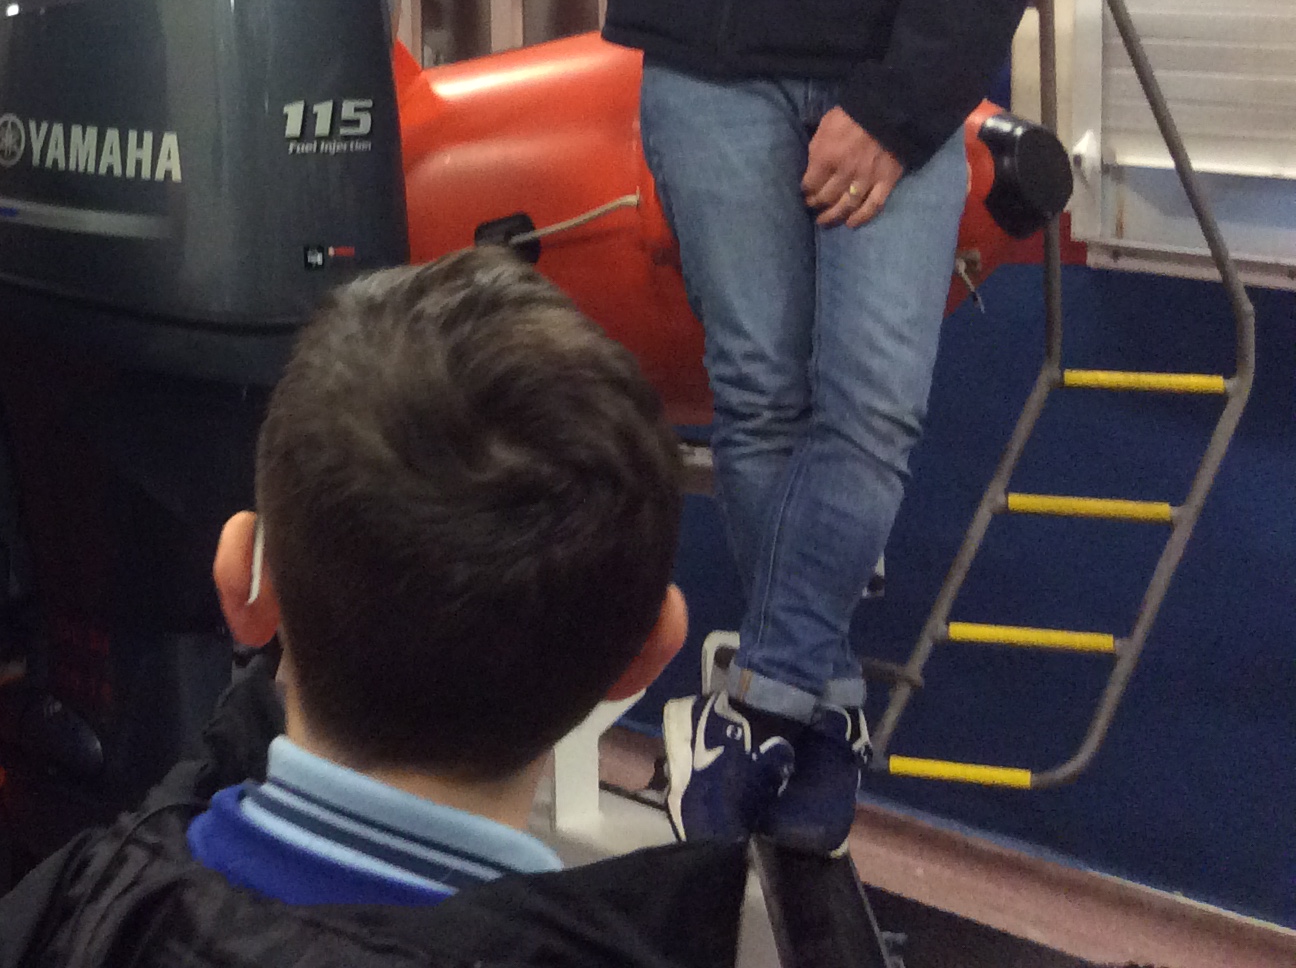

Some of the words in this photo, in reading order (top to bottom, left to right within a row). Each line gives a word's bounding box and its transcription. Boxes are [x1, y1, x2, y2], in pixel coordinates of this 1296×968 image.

[283, 98, 373, 138] 115
[29, 118, 182, 182] YAMAHA
[288, 139, 318, 155] Fuel
